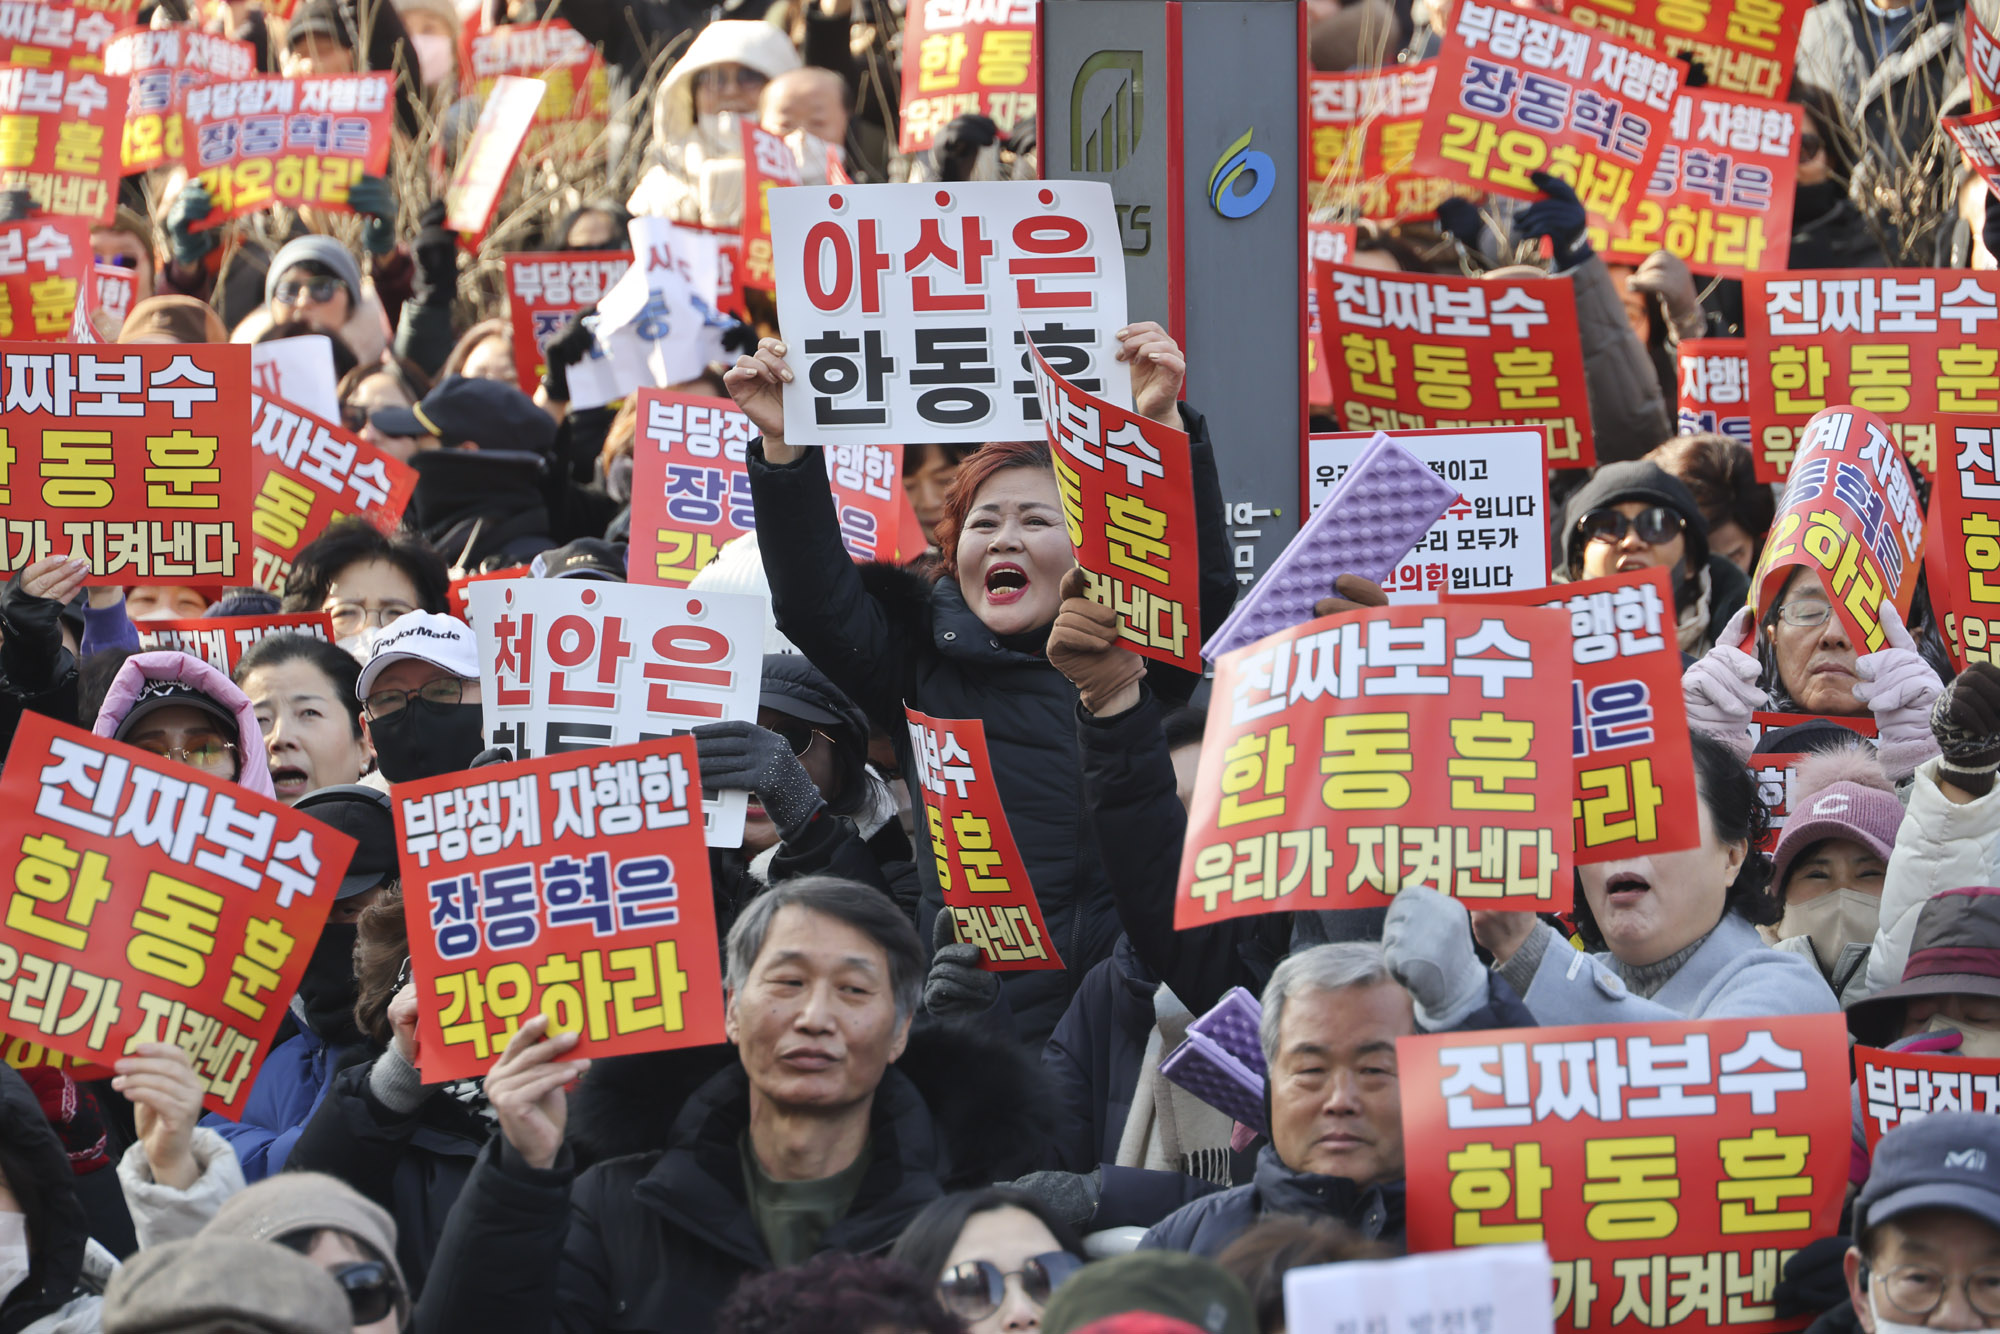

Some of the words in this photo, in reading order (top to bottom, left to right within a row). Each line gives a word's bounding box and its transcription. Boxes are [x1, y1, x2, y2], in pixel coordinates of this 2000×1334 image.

[186, 78, 295, 124] 부당징계
[1456, 1, 1592, 79] 부당징계
[1590, 41, 1680, 112] 자행한
[1459, 56, 1652, 164] 장동혁은
[1697, 99, 1796, 158] 자행한
[803, 215, 1096, 313] 아산은
[1331, 270, 1550, 339] 진짜보수
[1765, 277, 1999, 336] 진짜보수
[62, 520, 240, 577] 지켜낸다
[1456, 527, 1519, 552] 모두가
[371, 625, 461, 659] TaylorMade
[493, 613, 732, 718] 천안은
[1230, 617, 1534, 727] 진짜보수
[34, 735, 322, 910] 진짜보수
[402, 773, 543, 868] 부당징계
[549, 752, 692, 840] 자행한
[427, 850, 680, 962] 장동혁은
[1190, 825, 1334, 914] 우리가
[1346, 823, 1560, 901] 지켜낸다
[433, 938, 690, 1062] 각오하라
[1437, 1029, 1809, 1130] 진짜보수
